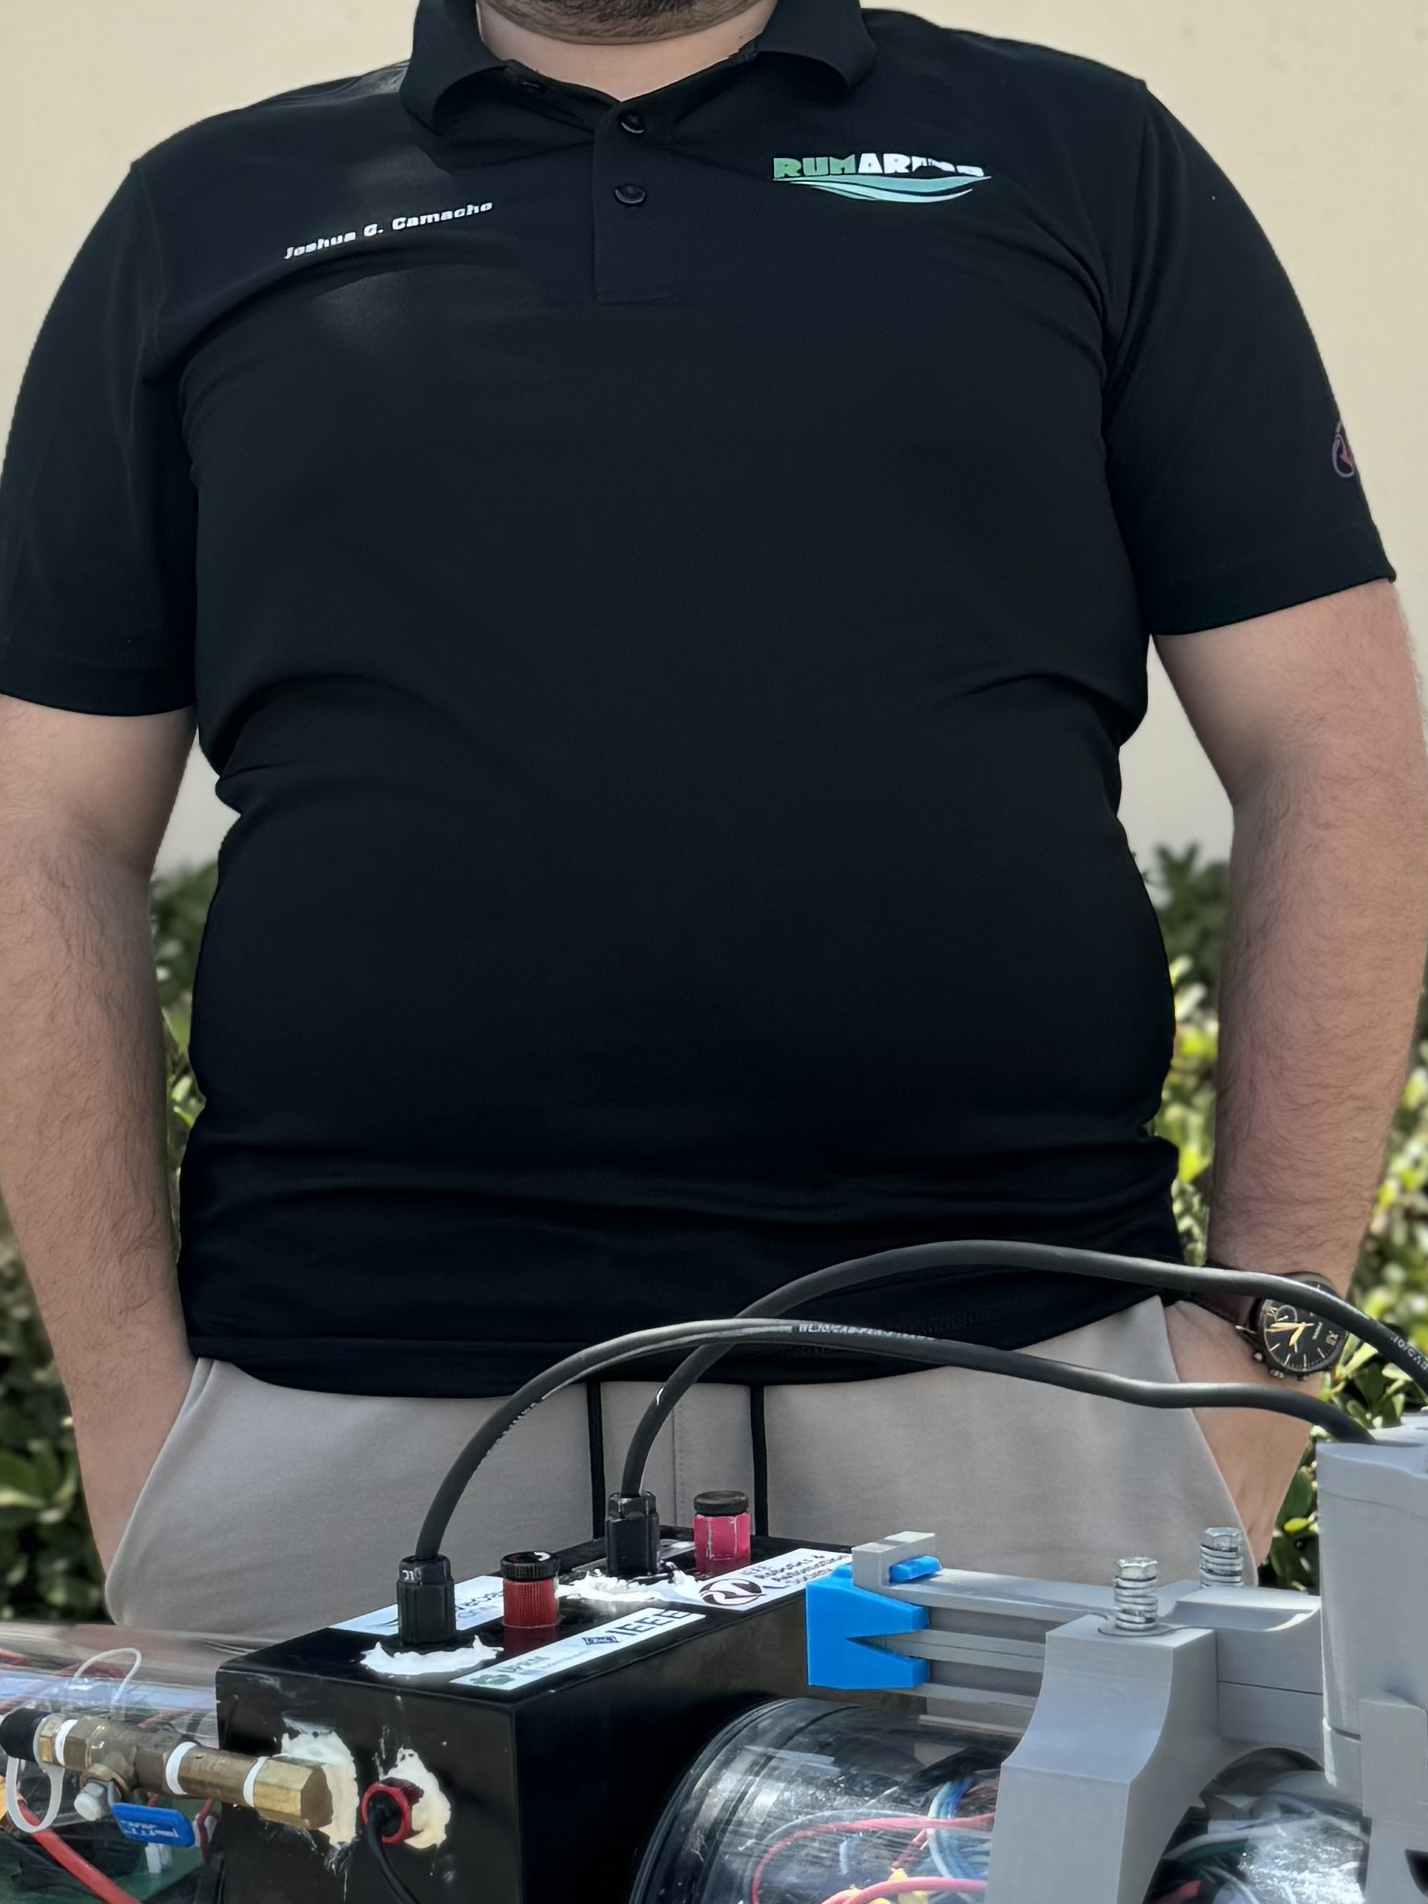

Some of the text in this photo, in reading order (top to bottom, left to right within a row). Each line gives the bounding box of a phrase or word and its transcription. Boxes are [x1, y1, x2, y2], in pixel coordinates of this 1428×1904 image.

[284, 231, 357, 260] Joshua
[391, 201, 493, 231] Camacho
[606, 1609, 693, 1638] IEEE
